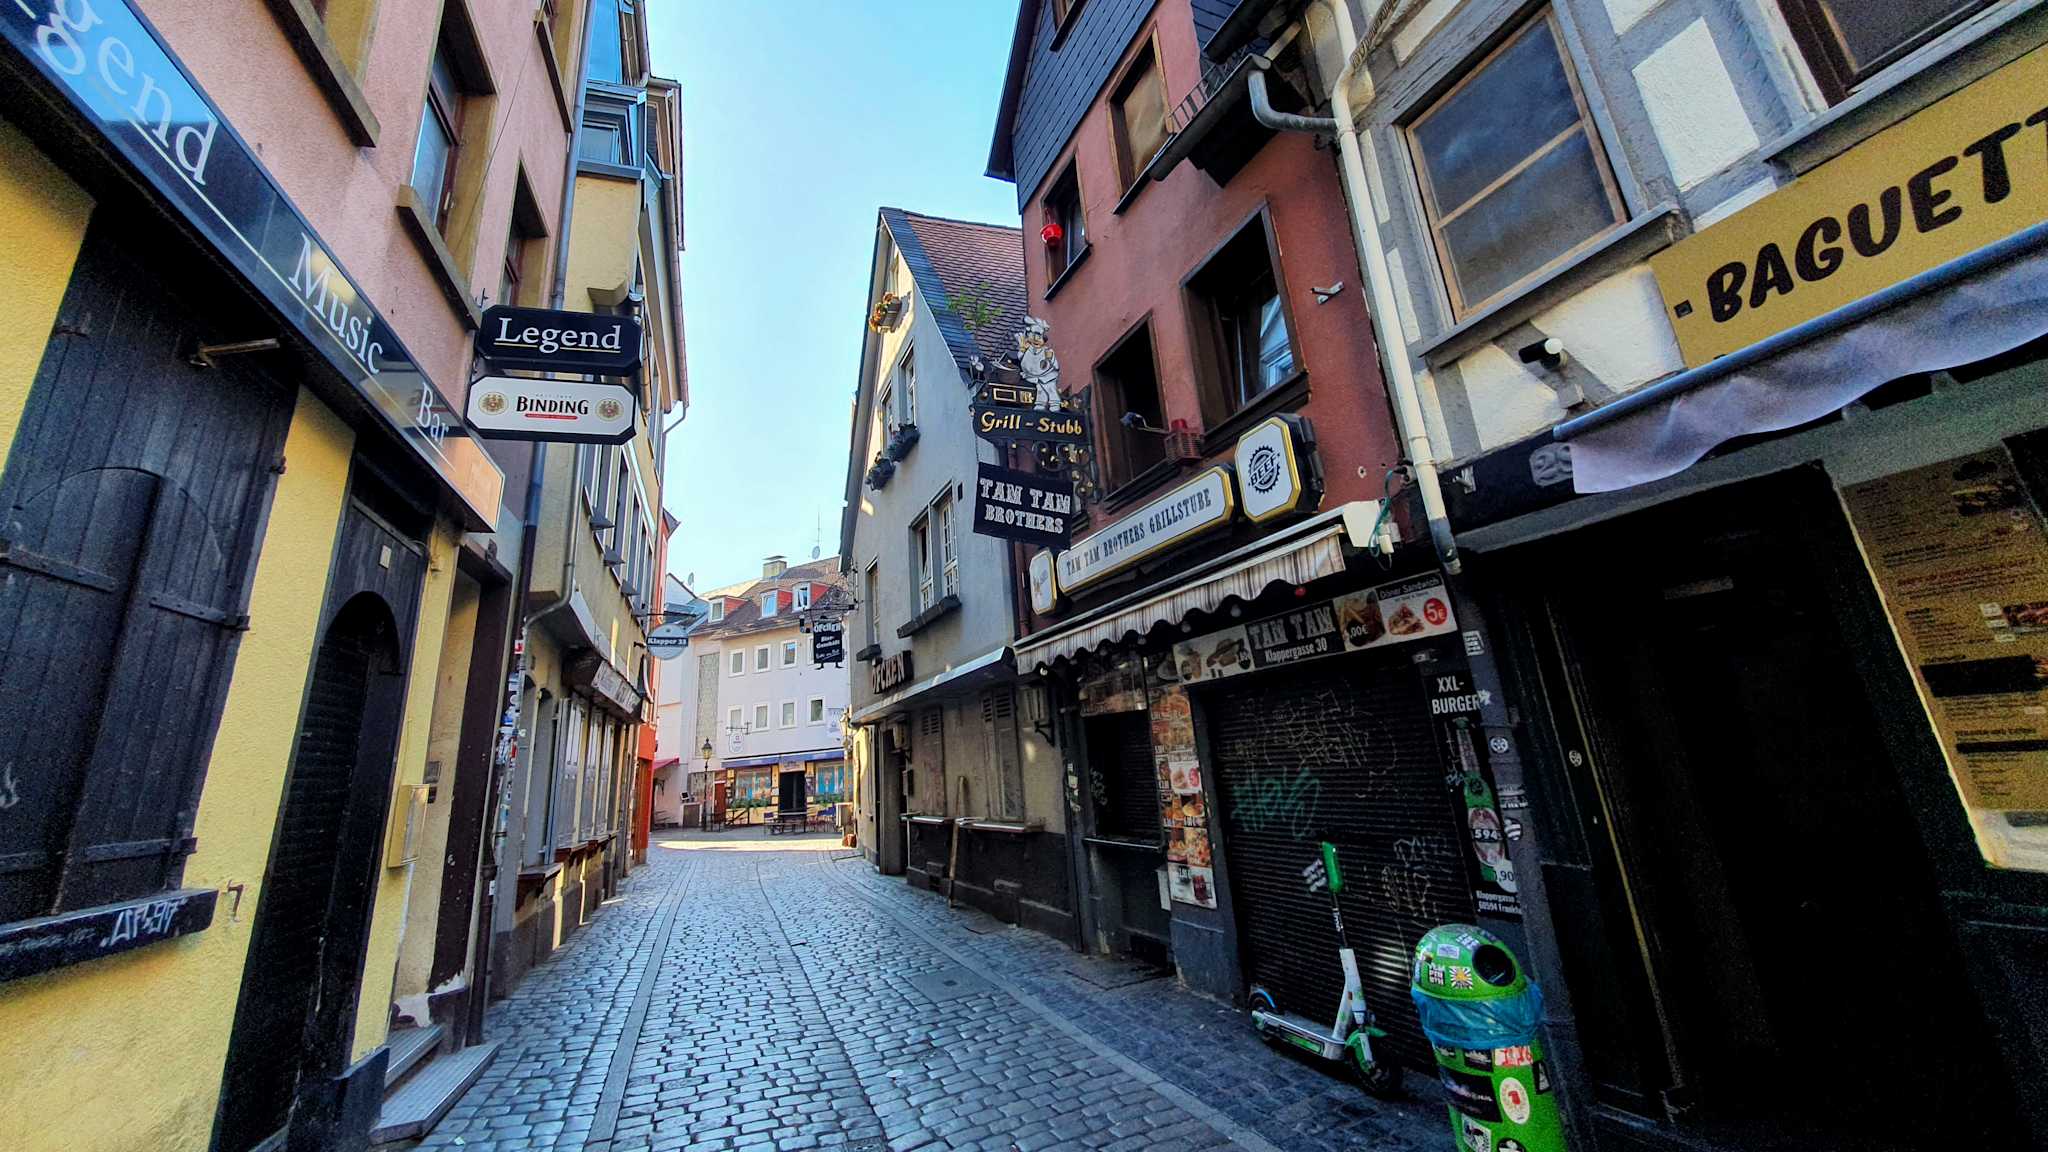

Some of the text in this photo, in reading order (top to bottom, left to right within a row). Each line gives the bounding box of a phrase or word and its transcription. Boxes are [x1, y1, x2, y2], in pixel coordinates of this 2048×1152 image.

[288, 232, 384, 374] Music
[416, 382, 450, 447] Bar
[494, 316, 622, 354] Legend
[516, 396, 590, 415] BINDING
[981, 411, 1021, 433] Grill
[1037, 417, 1083, 435] Stubb
[1250, 453, 1278, 486] BEEF
[979, 477, 1071, 514] TAM TAM
[984, 504, 1064, 534] BROTHERS
[1066, 555, 1081, 576] TAM
[1083, 546, 1101, 568] TAM
[1104, 523, 1146, 557] BROTHERS
[1149, 488, 1212, 533] GRILLSTUBE
[647, 638, 675, 647] Klapper
[1248, 607, 1336, 649] TAM TAM
[1265, 643, 1315, 663] Klappergasse
[1315, 637, 1328, 652] 30
[1437, 675, 1464, 693] XXL-
[1432, 693, 1481, 714] BURGER
